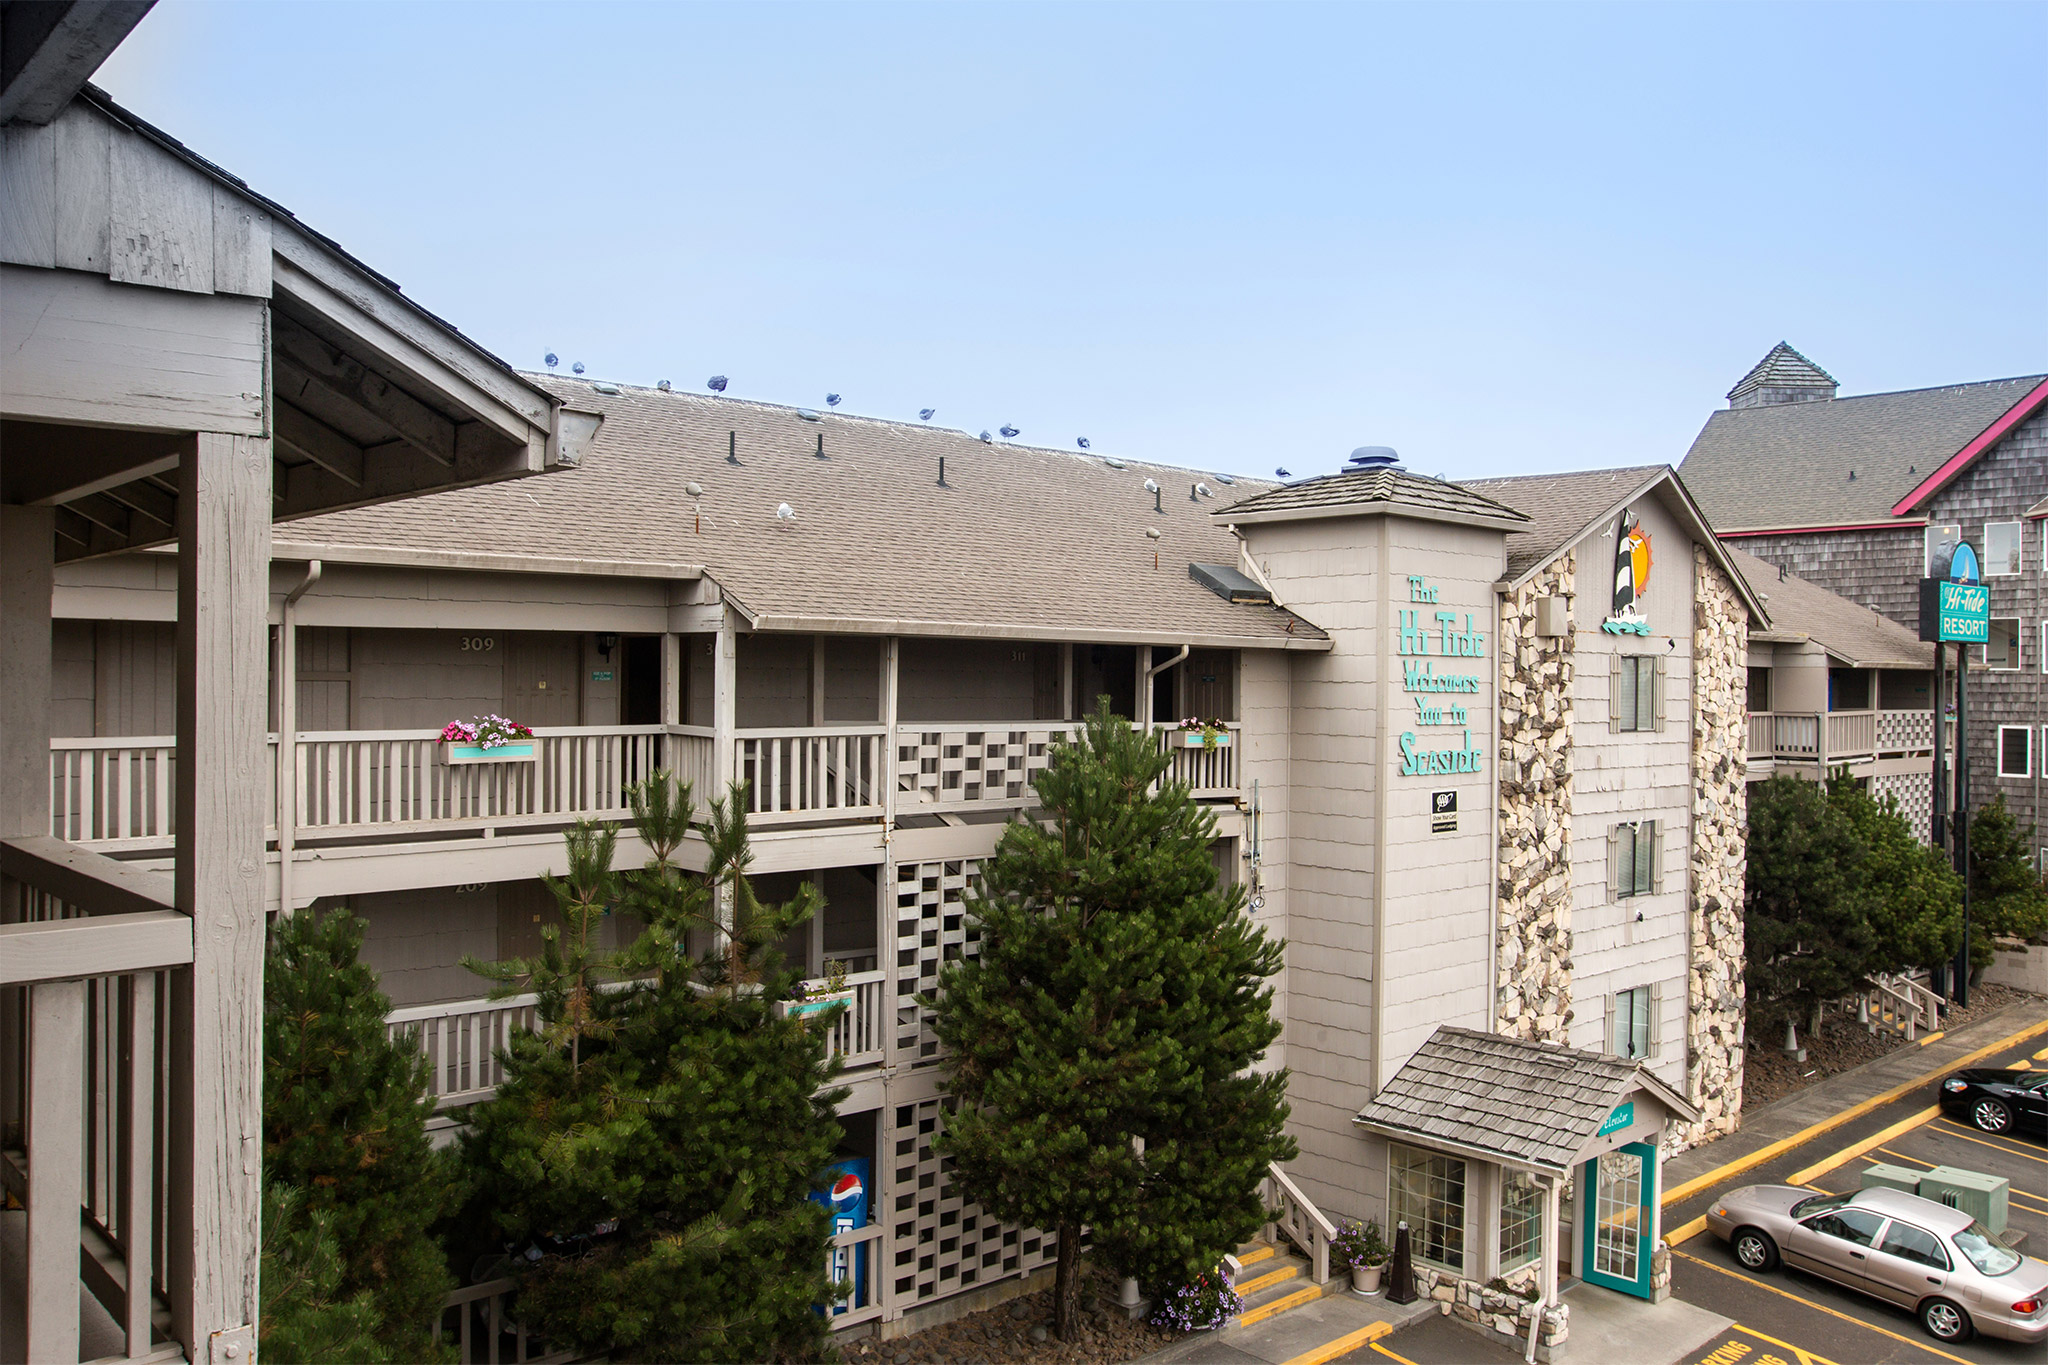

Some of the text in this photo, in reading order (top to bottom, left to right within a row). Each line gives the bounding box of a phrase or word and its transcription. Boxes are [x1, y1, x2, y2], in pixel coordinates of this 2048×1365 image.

[1408, 575, 1439, 604] The
[1944, 586, 1986, 613] Hi-Tide
[1399, 609, 1485, 657] Hi Tide
[1943, 617, 1986, 637] RESORT
[461, 636, 494, 651] 309
[1415, 695, 1467, 726] You to
[1400, 729, 1483, 776] Seaside
[1694, 1340, 1752, 1365] RKING
